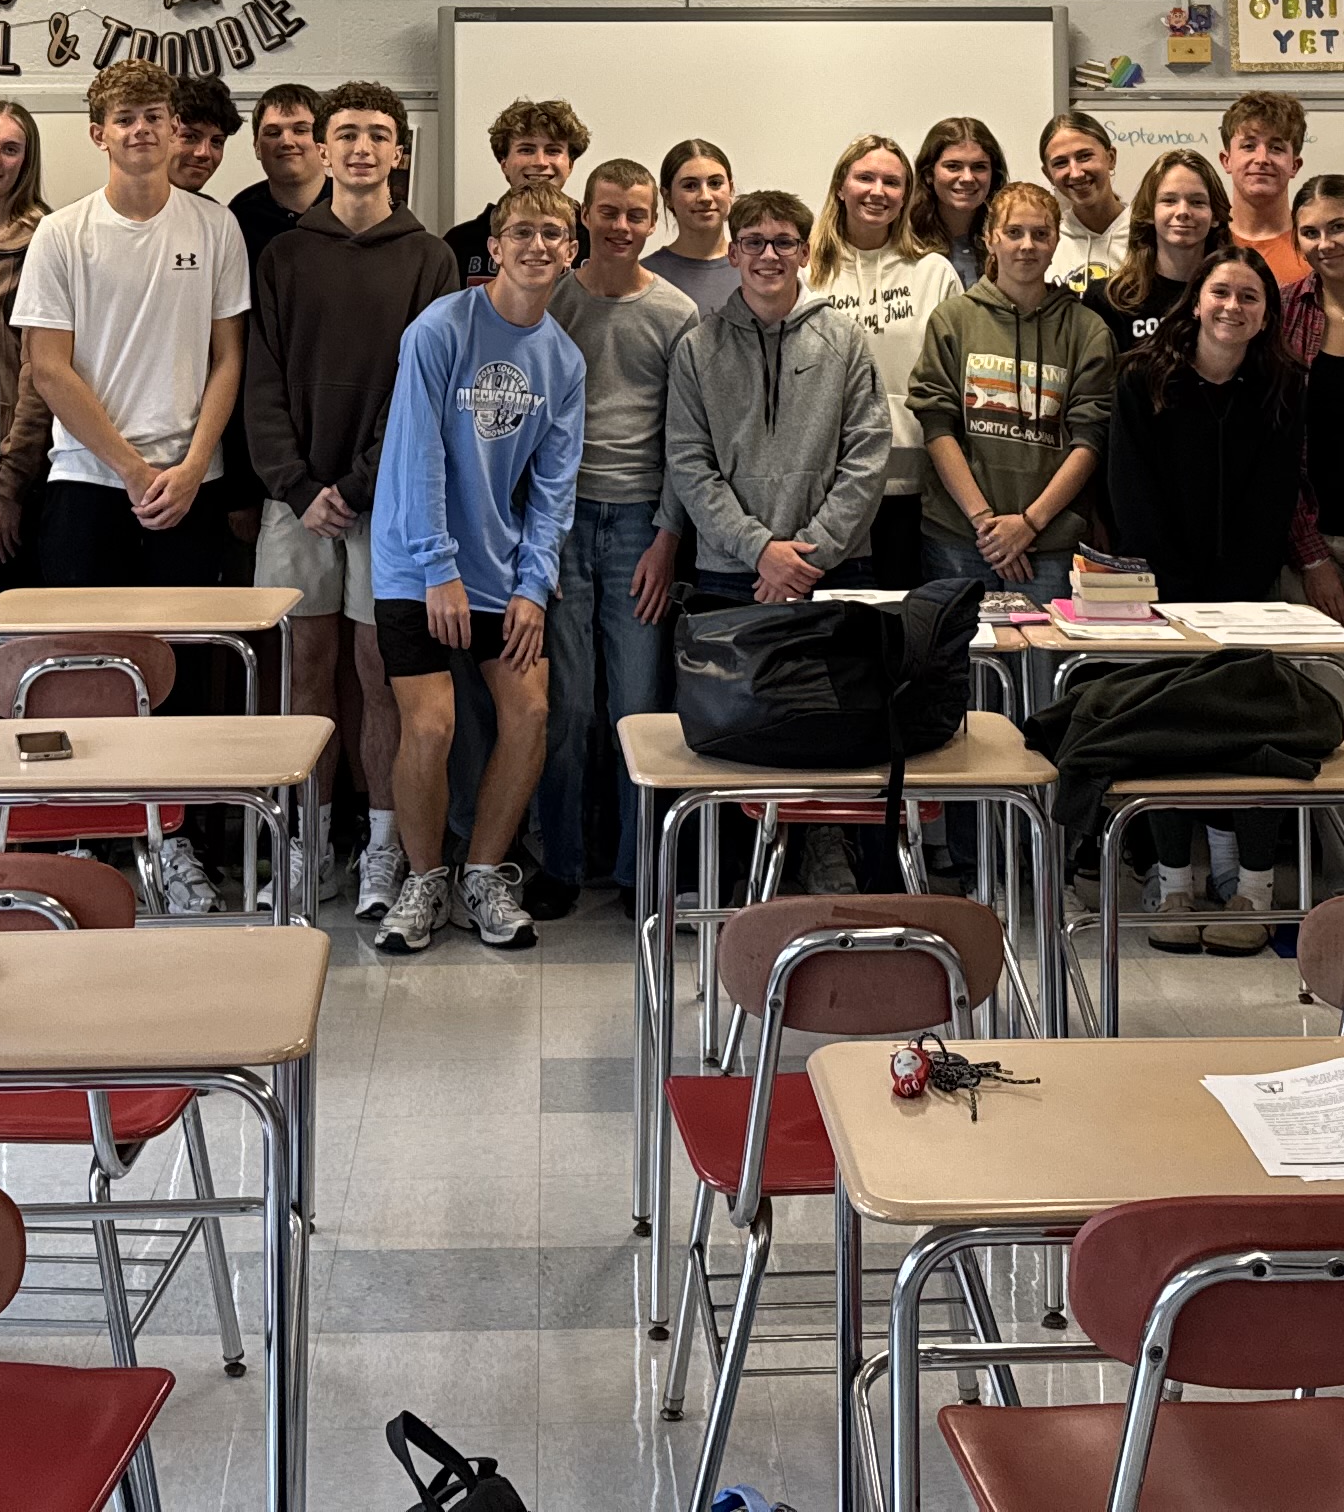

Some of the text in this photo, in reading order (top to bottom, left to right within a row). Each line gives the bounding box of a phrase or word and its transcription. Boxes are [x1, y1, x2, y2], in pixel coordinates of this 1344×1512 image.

[47, 12, 80, 67] &
[1104, 120, 1208, 147] September
[883, 300, 914, 324] Irish
[970, 355, 1018, 373] OUTE
[969, 419, 1007, 436] NORTH
